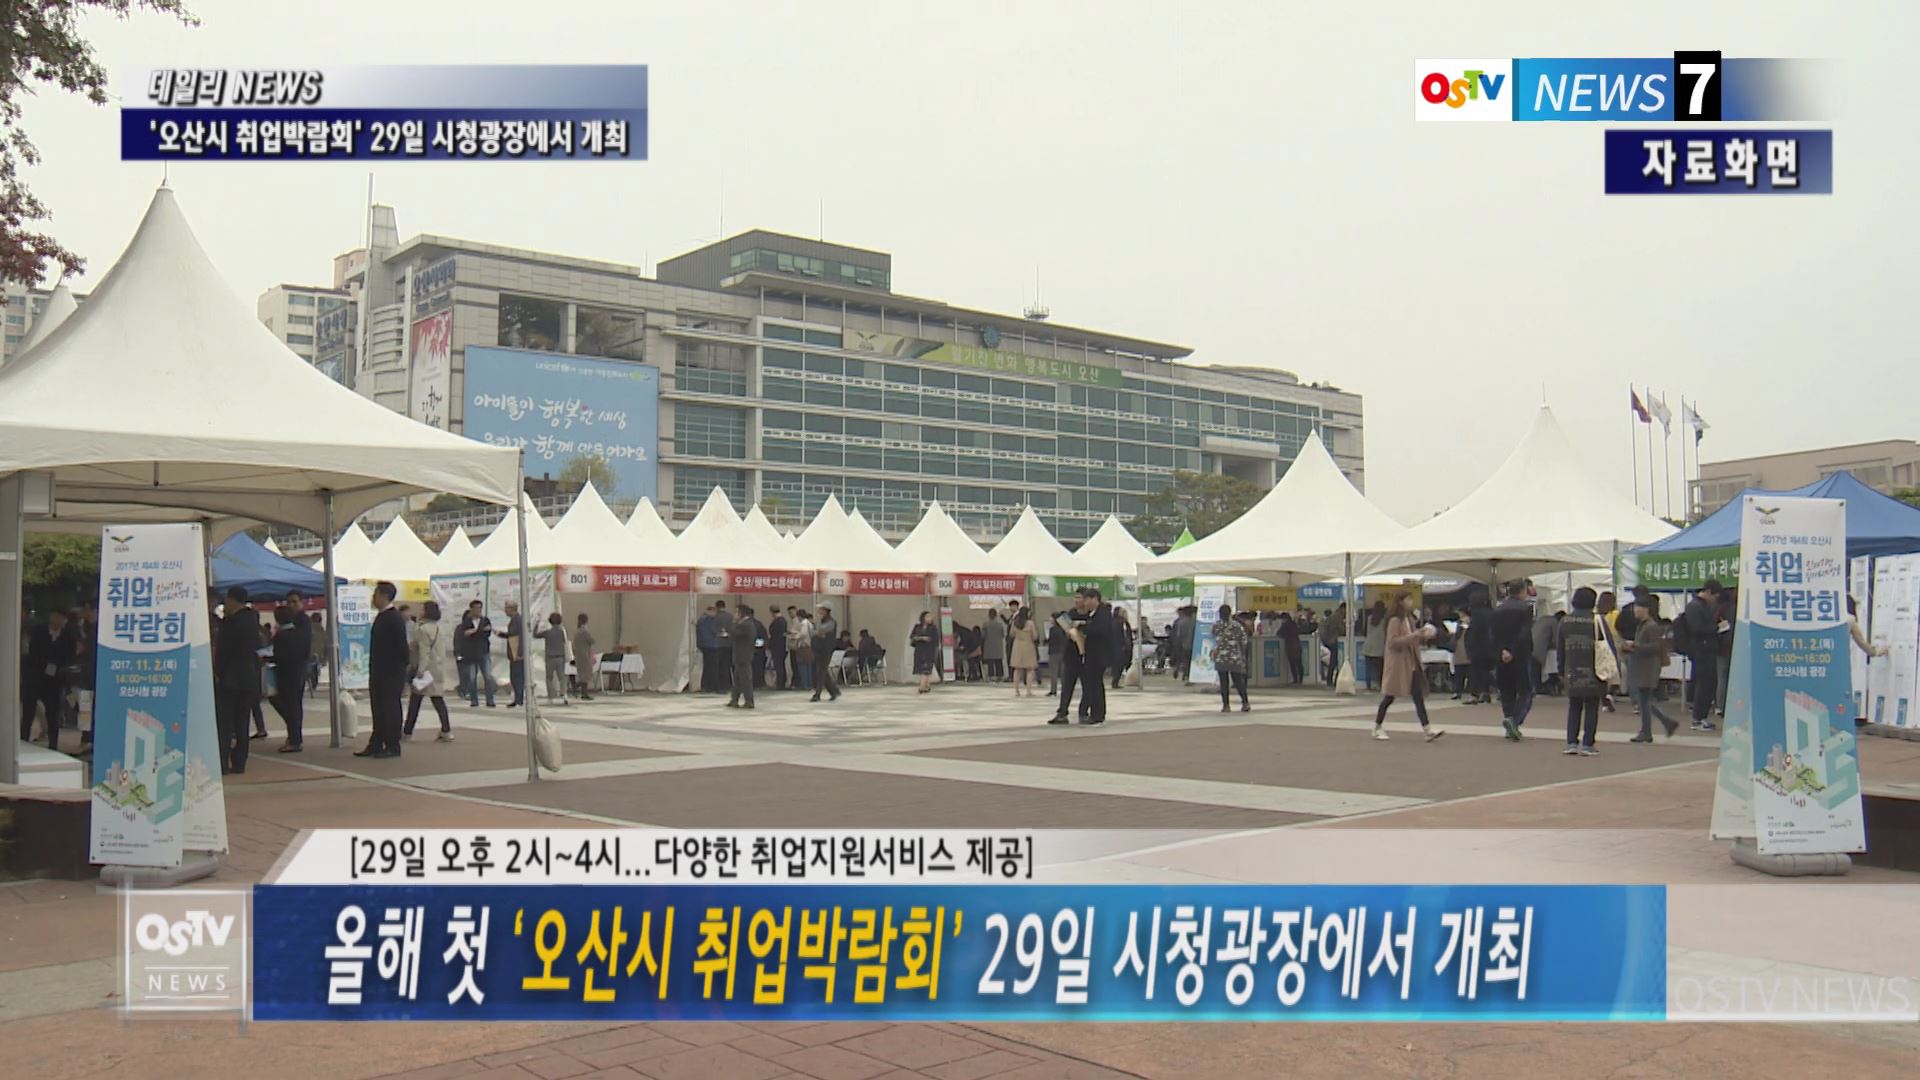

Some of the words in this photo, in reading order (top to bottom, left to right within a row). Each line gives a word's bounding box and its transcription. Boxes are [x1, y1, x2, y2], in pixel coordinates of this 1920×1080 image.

[1079, 365, 1099, 382] 오산
[474, 394, 534, 421] 아이들이
[539, 398, 593, 429] 행복한
[599, 410, 627, 430] 세상
[532, 434, 574, 460] 함께
[1762, 534, 1787, 545] 2017년
[1811, 536, 1832, 546] 오산시
[162, 560, 183, 570] 오산시
[1645, 557, 1740, 581] 안내데스크/일자리센
[1755, 551, 1803, 583] 취업
[107, 576, 153, 608] 취업
[603, 574, 640, 586] 기업지원
[1764, 590, 1841, 622] 박람회
[114, 612, 187, 643] 박람회
